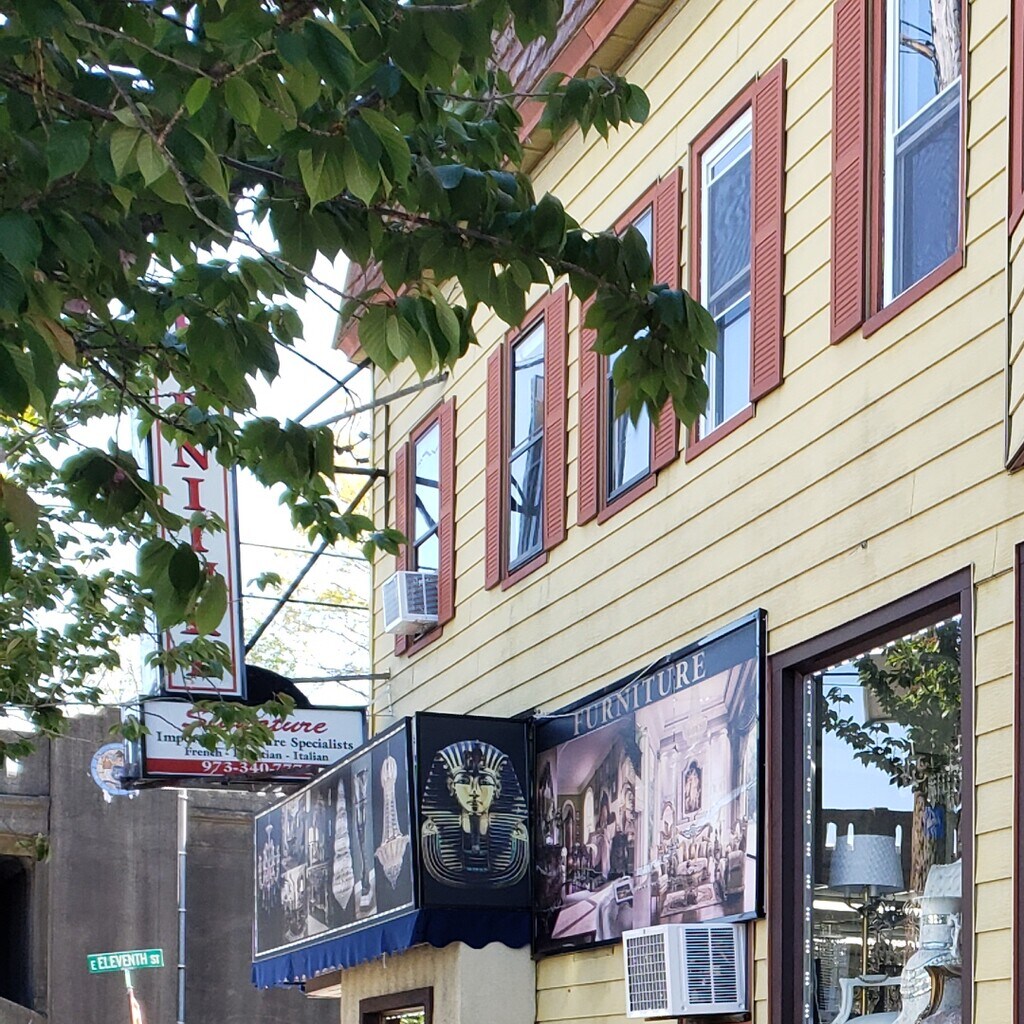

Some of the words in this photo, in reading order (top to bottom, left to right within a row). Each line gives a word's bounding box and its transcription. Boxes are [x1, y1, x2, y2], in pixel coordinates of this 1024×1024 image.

[573, 652, 706, 736] FURNITURE
[182, 708, 328, 734] Sture
[290, 737, 354, 751] Specialists
[293, 751, 329, 761] Italian
[90, 960, 97, 970] E
[97, 952, 148, 970] ELEVENTH
[149, 954, 160, 965] ST
